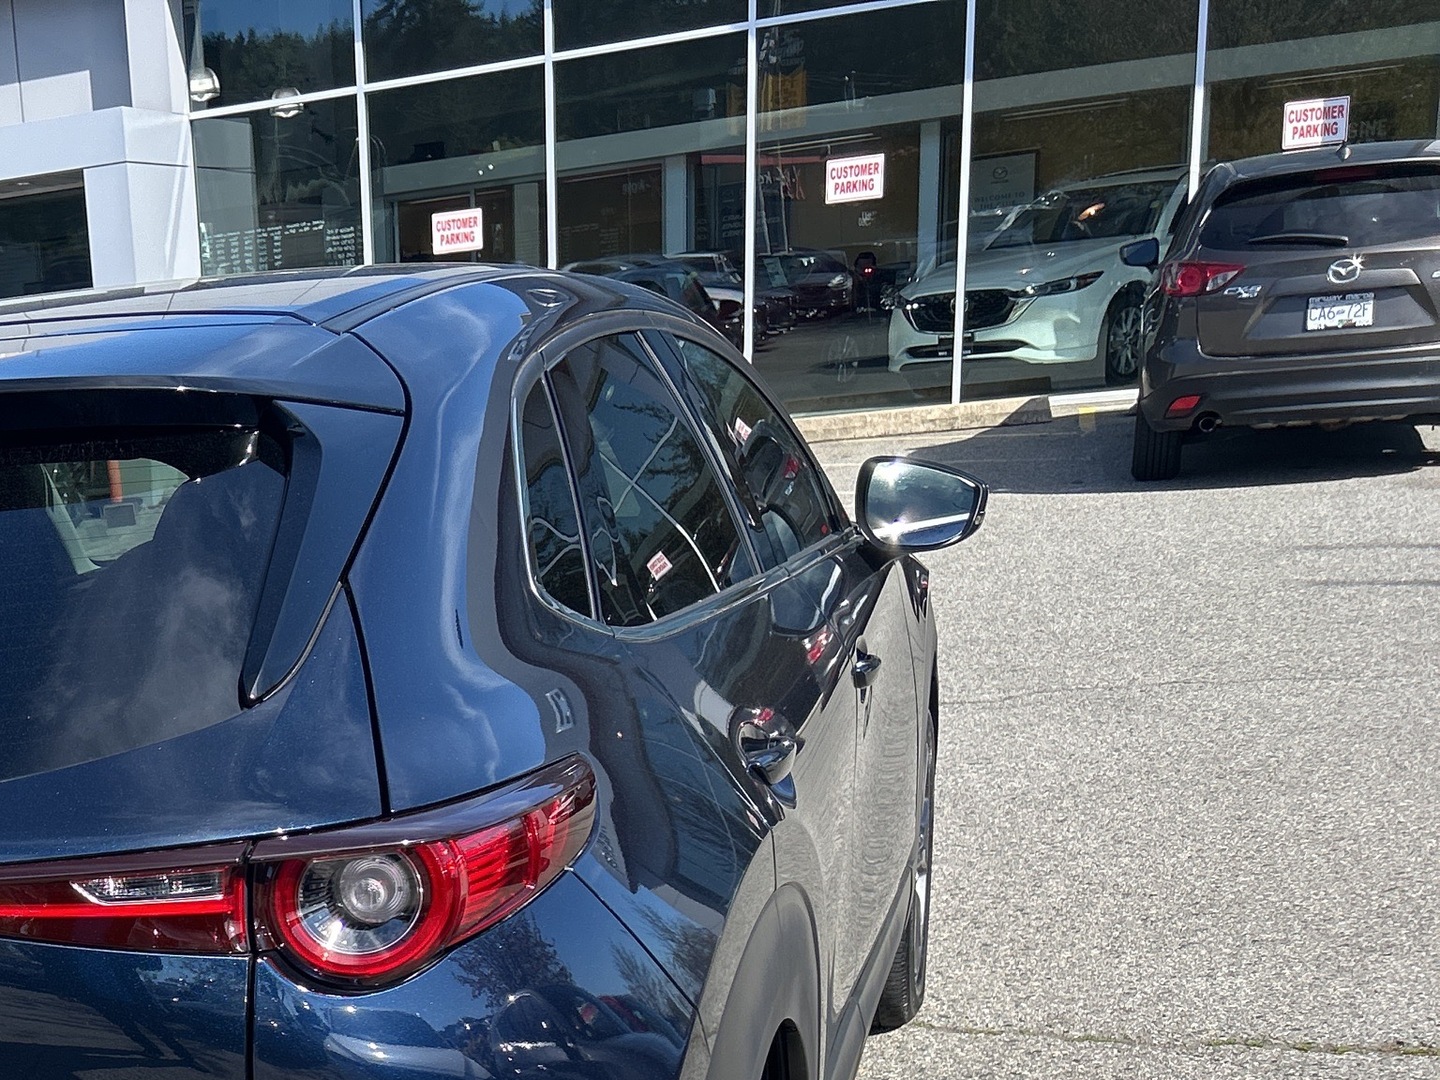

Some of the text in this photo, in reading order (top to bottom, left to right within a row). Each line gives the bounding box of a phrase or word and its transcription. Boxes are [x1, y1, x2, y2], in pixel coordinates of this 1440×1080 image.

[1288, 105, 1345, 124] CUSTOMER
[1292, 121, 1339, 140] PARKING
[830, 162, 880, 180] CUSTOMER
[834, 178, 875, 195] PARKING
[436, 216, 478, 232] CUSTOMER
[440, 231, 476, 246] PARKING
